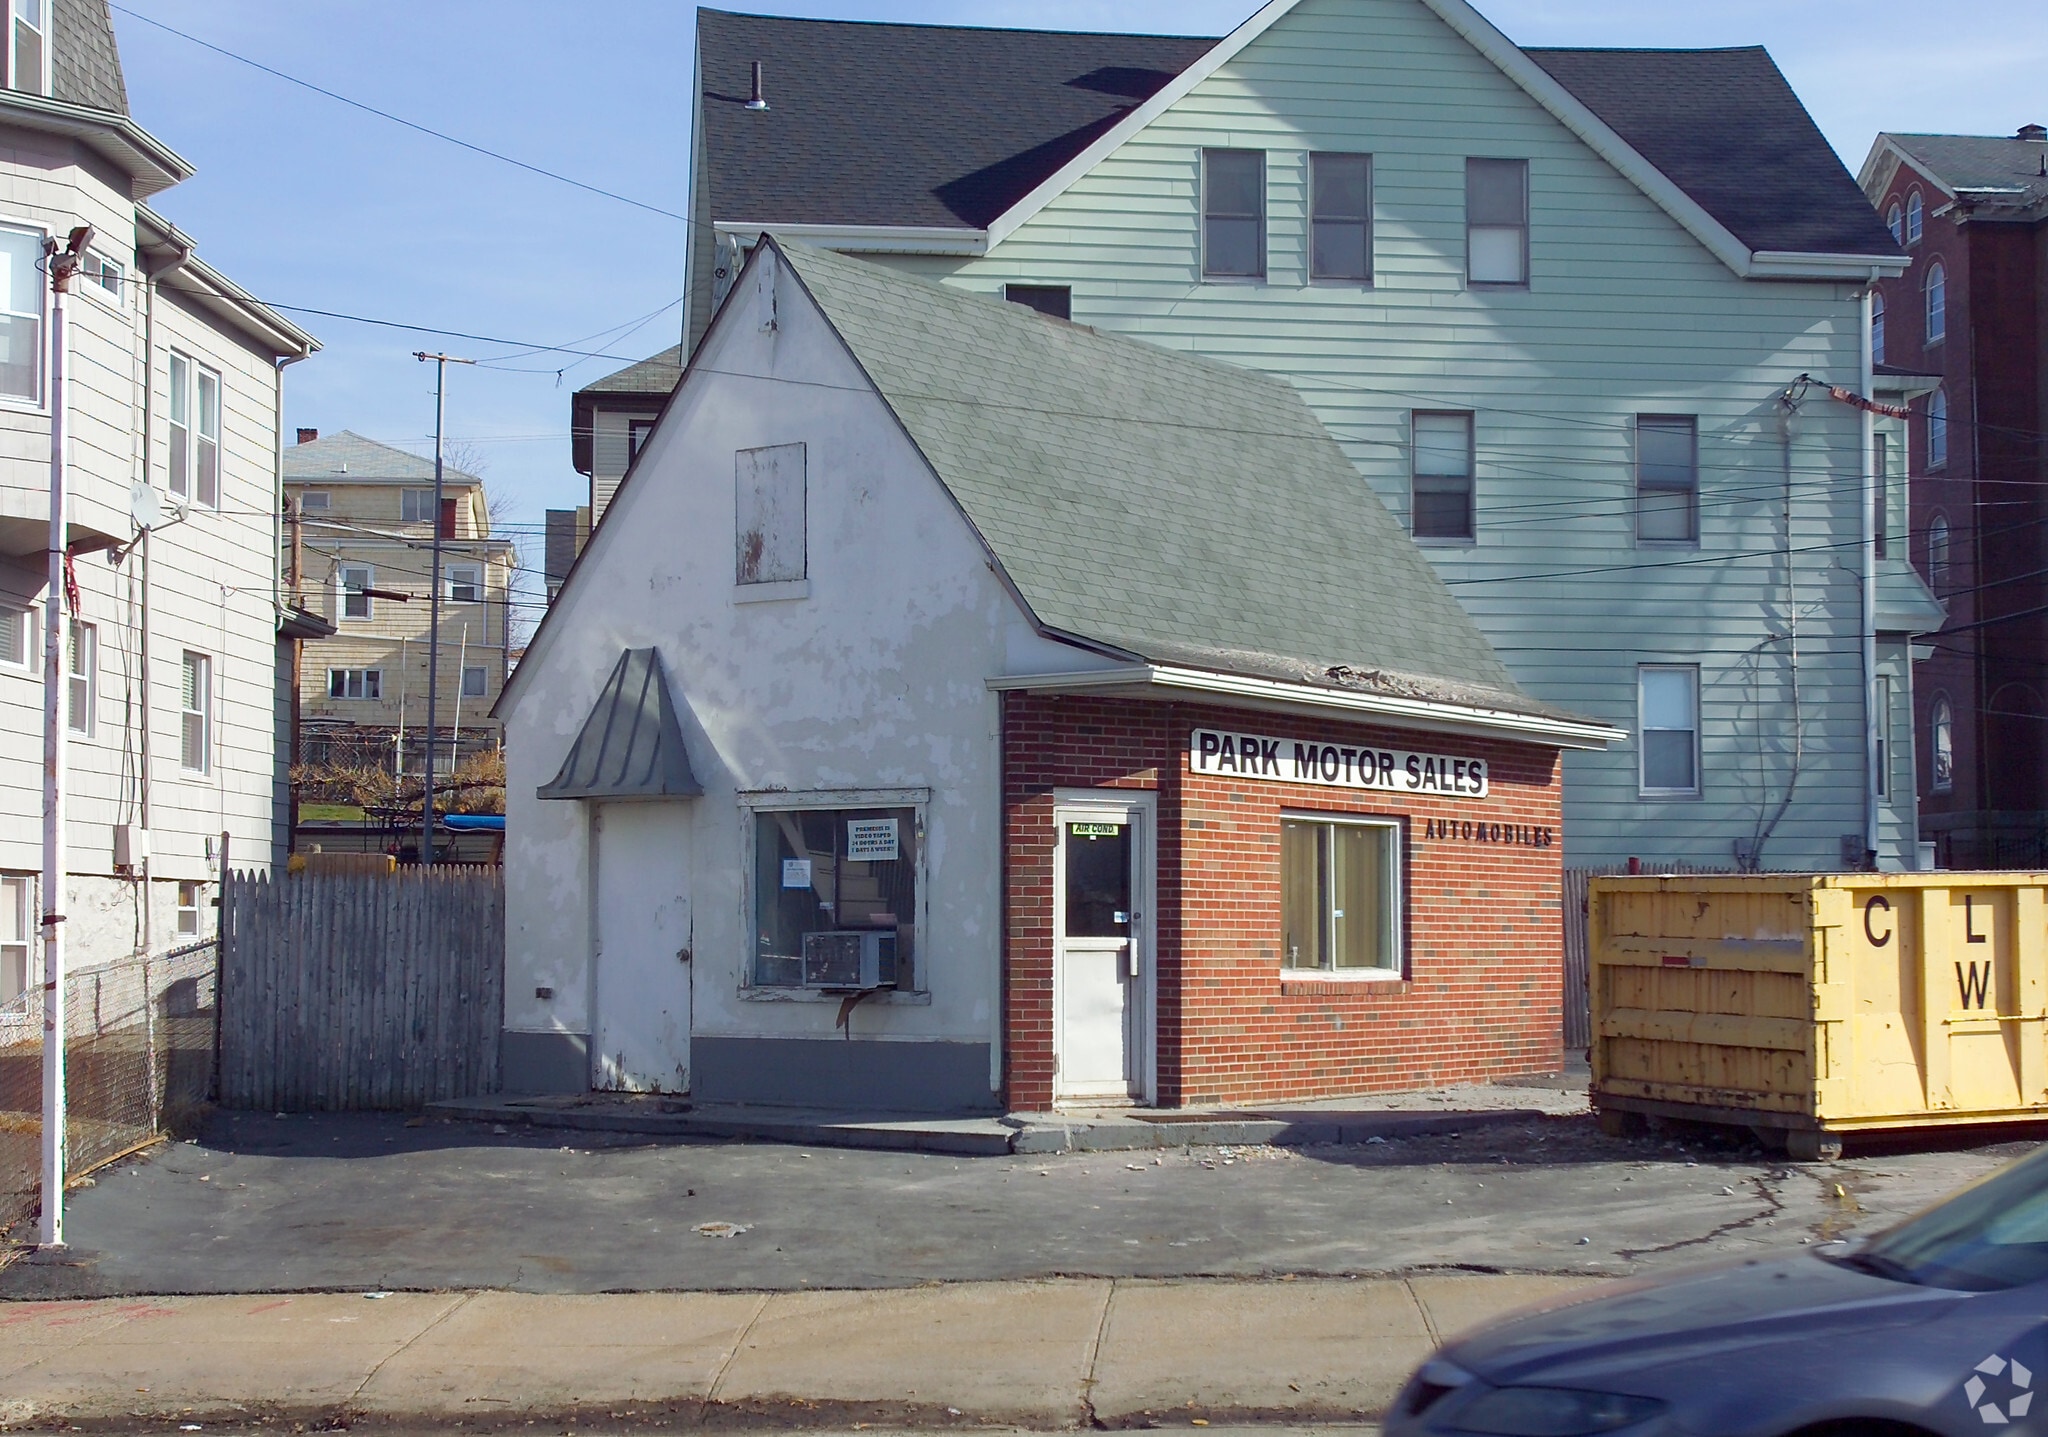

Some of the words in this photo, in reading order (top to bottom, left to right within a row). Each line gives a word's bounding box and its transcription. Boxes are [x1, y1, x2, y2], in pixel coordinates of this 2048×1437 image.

[1200, 732, 1280, 776] PARK
[1294, 743, 1395, 787] MOTOR
[1406, 754, 1483, 794] SALES
[1075, 823, 1090, 833] AIR
[1425, 818, 1552, 847] AUTOMOBILES
[1864, 894, 1892, 948] C
[1965, 894, 1986, 943] L
[1954, 960, 1991, 1010] W
